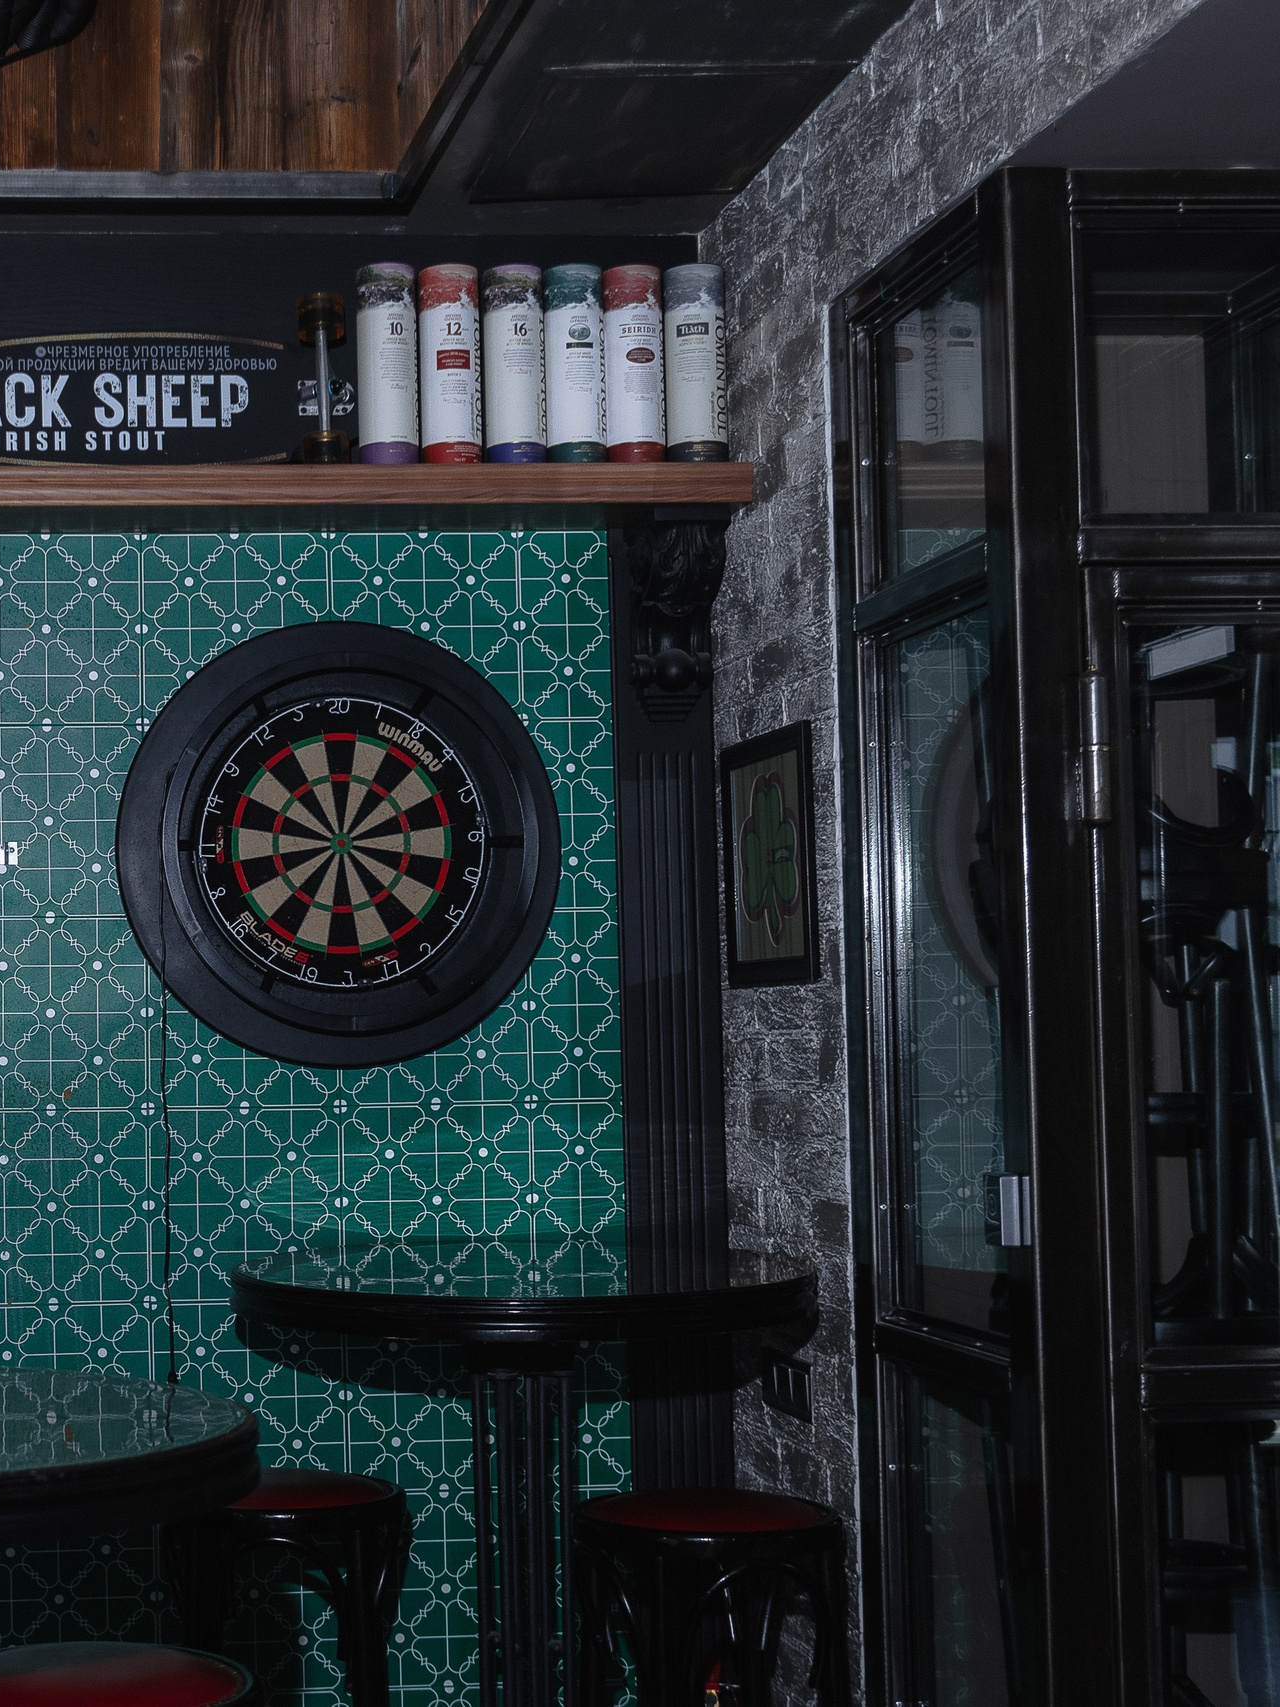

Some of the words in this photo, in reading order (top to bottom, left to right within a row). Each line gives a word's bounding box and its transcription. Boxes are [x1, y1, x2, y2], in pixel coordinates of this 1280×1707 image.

[389, 322, 403, 336] 10
[446, 322, 462, 336] 12
[512, 322, 527, 336] 16
[47, 345, 129, 358] ЧРЕЗМЕРНОЕ
[133, 345, 230, 358] УПОТРЕБЛЕНИЕ
[18, 358, 95, 372] ПРОДУКЦИИ
[100, 358, 148, 372] ВРЕДИТ
[152, 358, 205, 370] ВАШЕМУ
[208, 358, 277, 372] ЗДОРОВЬЮ
[715, 314, 726, 436] TOMINTOUL
[93, 373, 249, 428] SHEEP
[85, 431, 166, 452] STOUT
[328, 698, 350, 714] 20
[374, 702, 382, 720] 1
[293, 708, 304, 722] 5
[251, 724, 275, 746] 12
[407, 719, 426, 740] 18
[442, 749, 454, 764] 4
[224, 762, 240, 777] 9
[458, 780, 478, 804] 13
[205, 794, 224, 816] 14
[468, 830, 484, 843] 6
[200, 844, 216, 858] 11
[462, 867, 482, 888] 10
[210, 887, 226, 900] 8
[444, 904, 464, 928] 15
[227, 918, 250, 940] 16
[266, 946, 278, 964] 7
[420, 942, 432, 954] 2
[296, 964, 318, 984] 19
[342, 970, 354, 987] 3
[381, 960, 400, 981] 17
